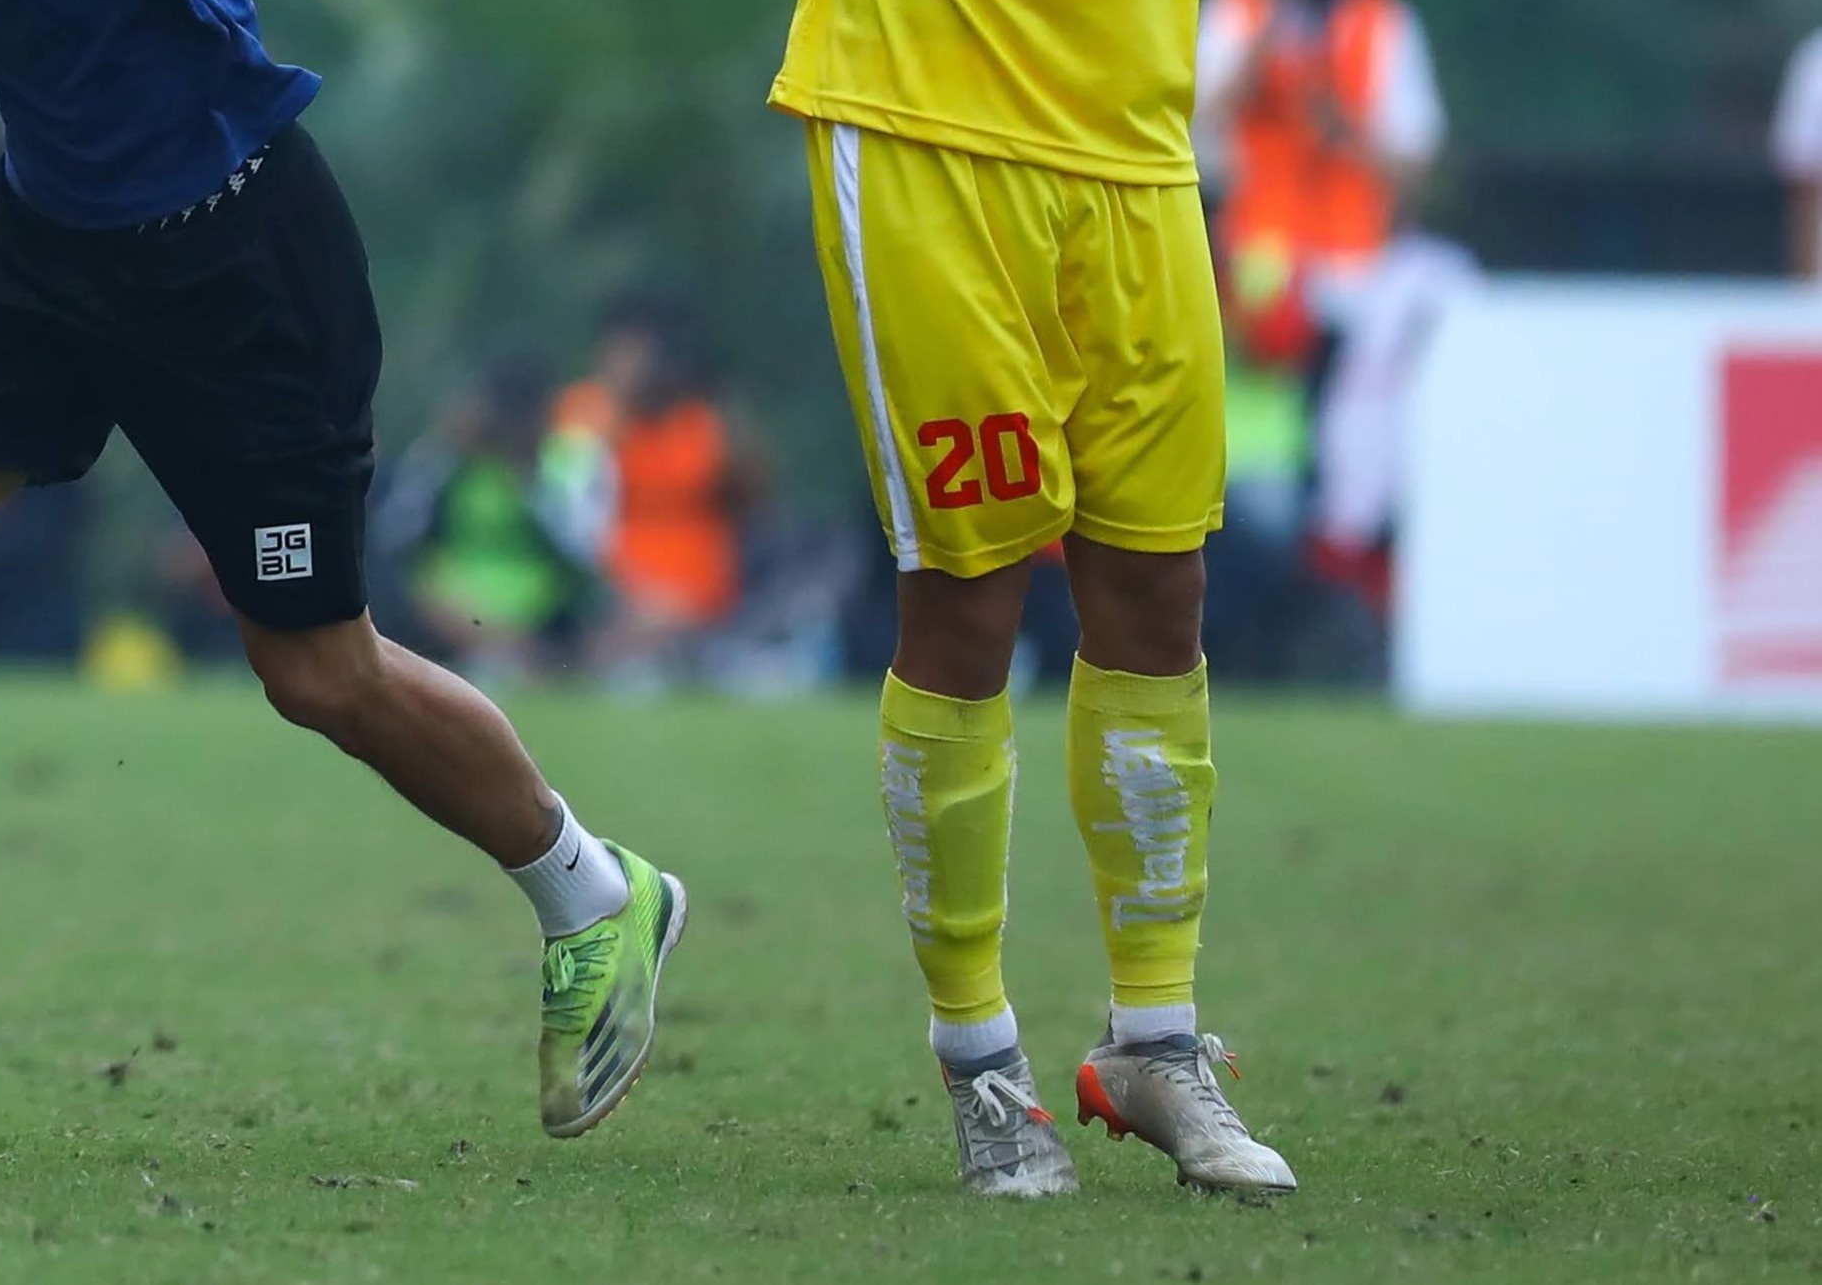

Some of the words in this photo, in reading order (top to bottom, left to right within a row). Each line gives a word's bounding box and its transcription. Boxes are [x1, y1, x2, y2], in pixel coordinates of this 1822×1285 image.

[917, 411, 1043, 509] 20
[261, 529, 306, 553] JG
[261, 554, 307, 576] BL
